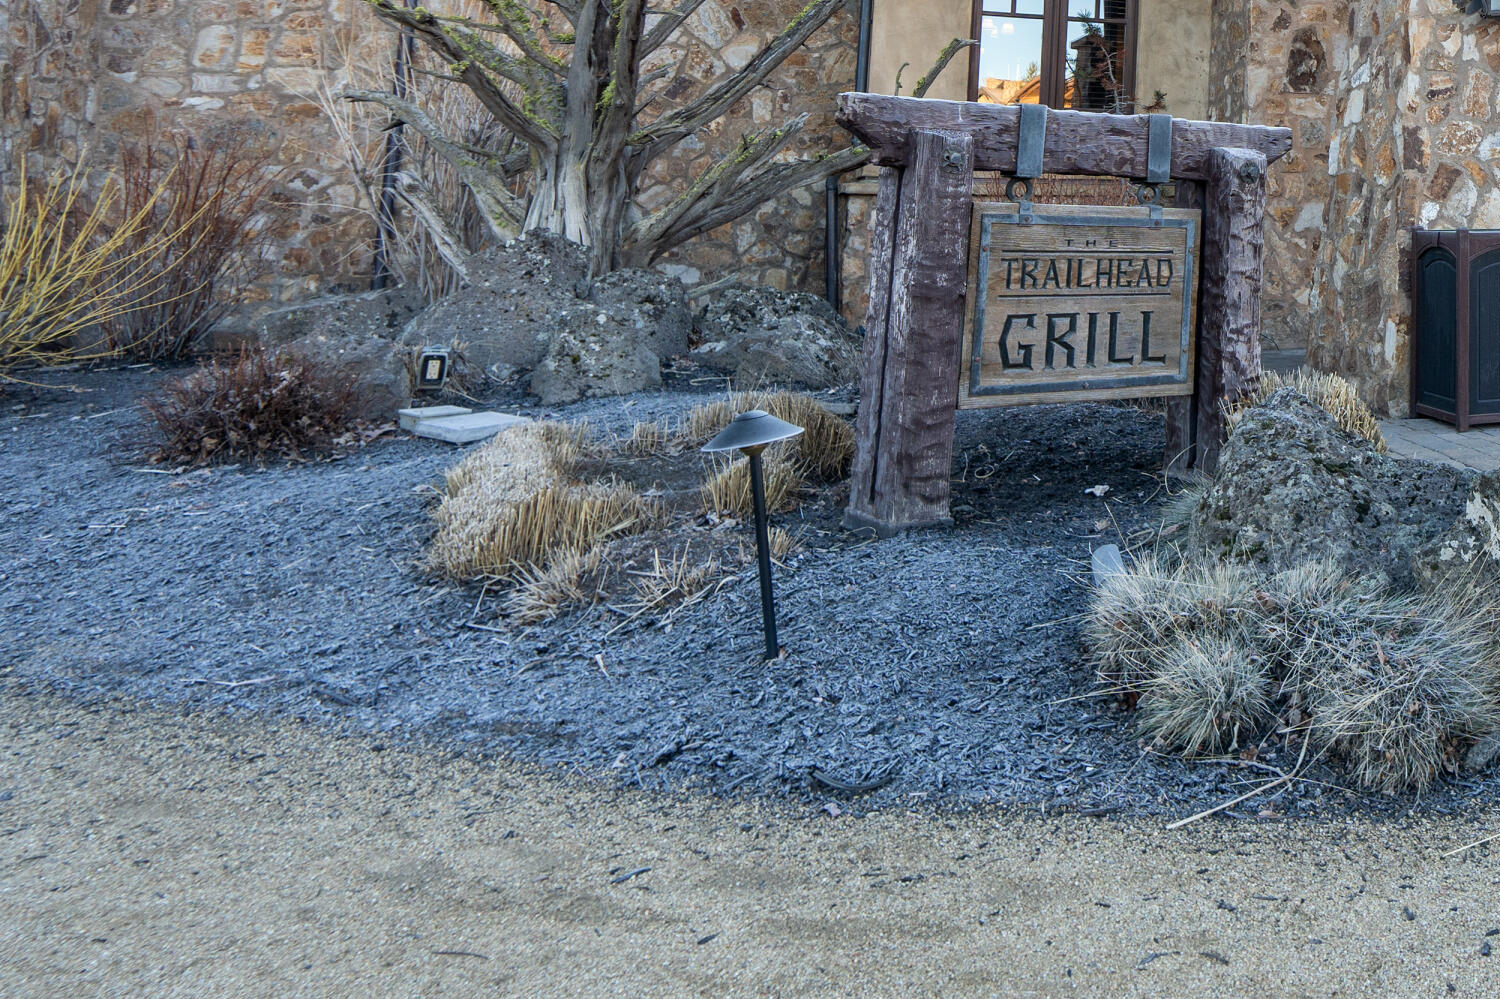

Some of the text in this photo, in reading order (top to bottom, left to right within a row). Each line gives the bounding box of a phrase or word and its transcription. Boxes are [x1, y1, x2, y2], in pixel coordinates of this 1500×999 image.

[1064, 238, 1121, 248] THE
[1001, 258, 1173, 290] TRAILHEAD
[999, 310, 1167, 372] GRILL
